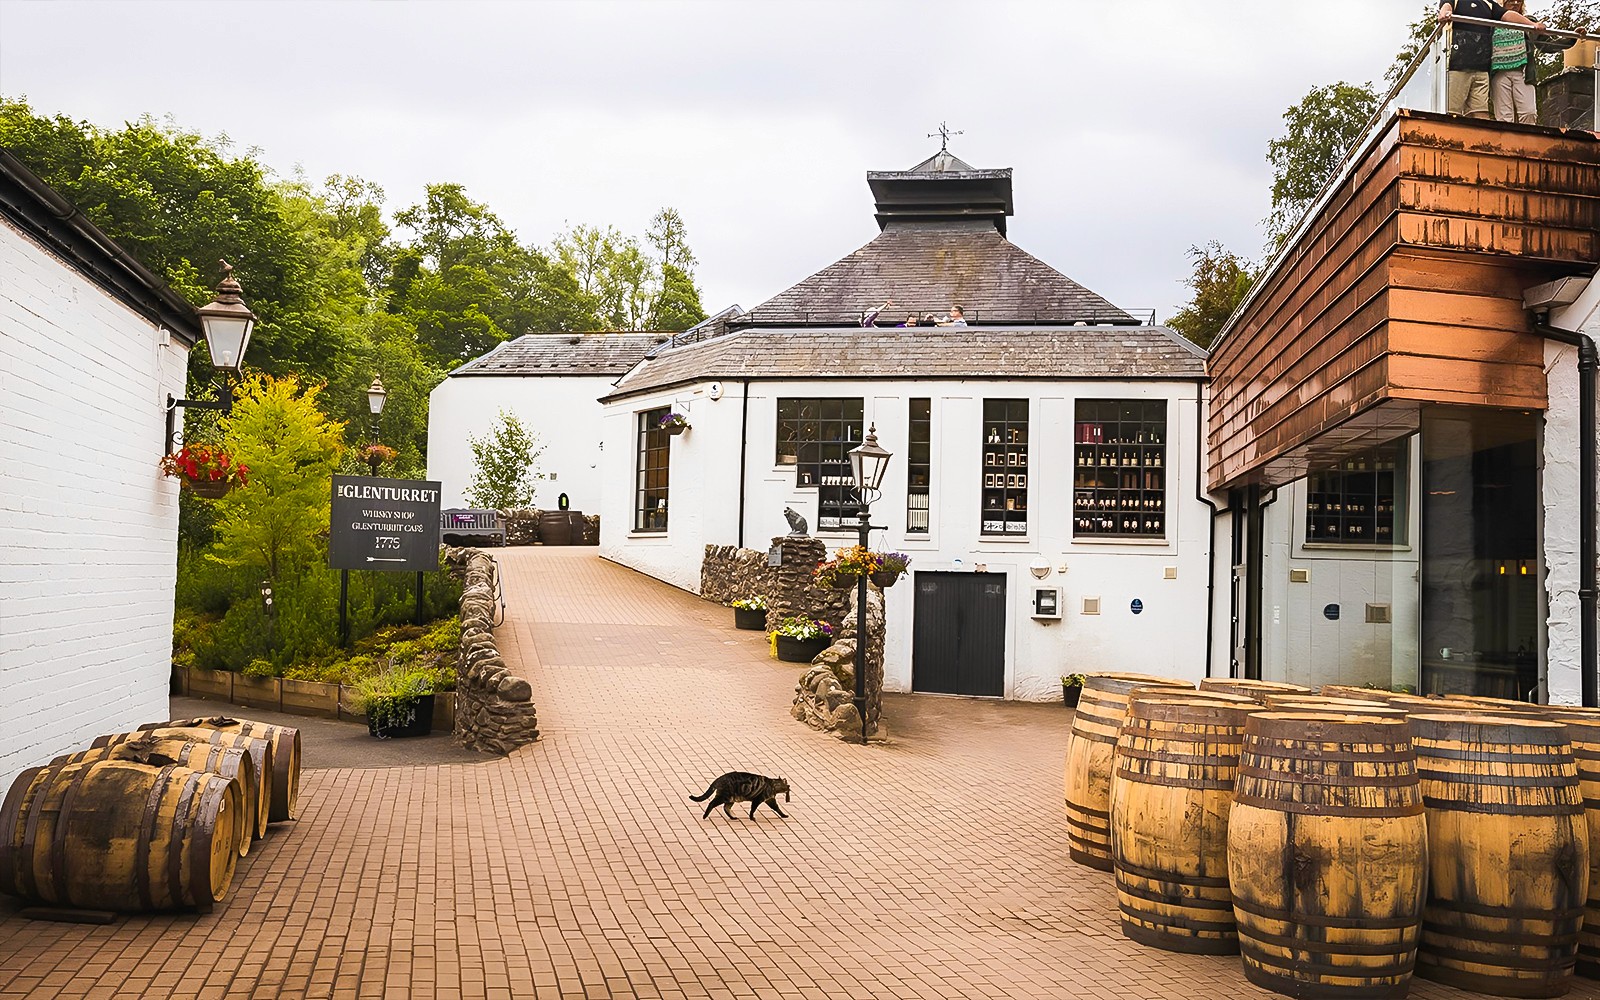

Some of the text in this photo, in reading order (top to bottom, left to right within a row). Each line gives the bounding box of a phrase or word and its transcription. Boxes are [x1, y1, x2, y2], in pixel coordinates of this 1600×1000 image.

[344, 484, 438, 503] GLENTURRET
[362, 509, 415, 520] WHISKY SHOP
[351, 521, 403, 532] GLENTURRET
